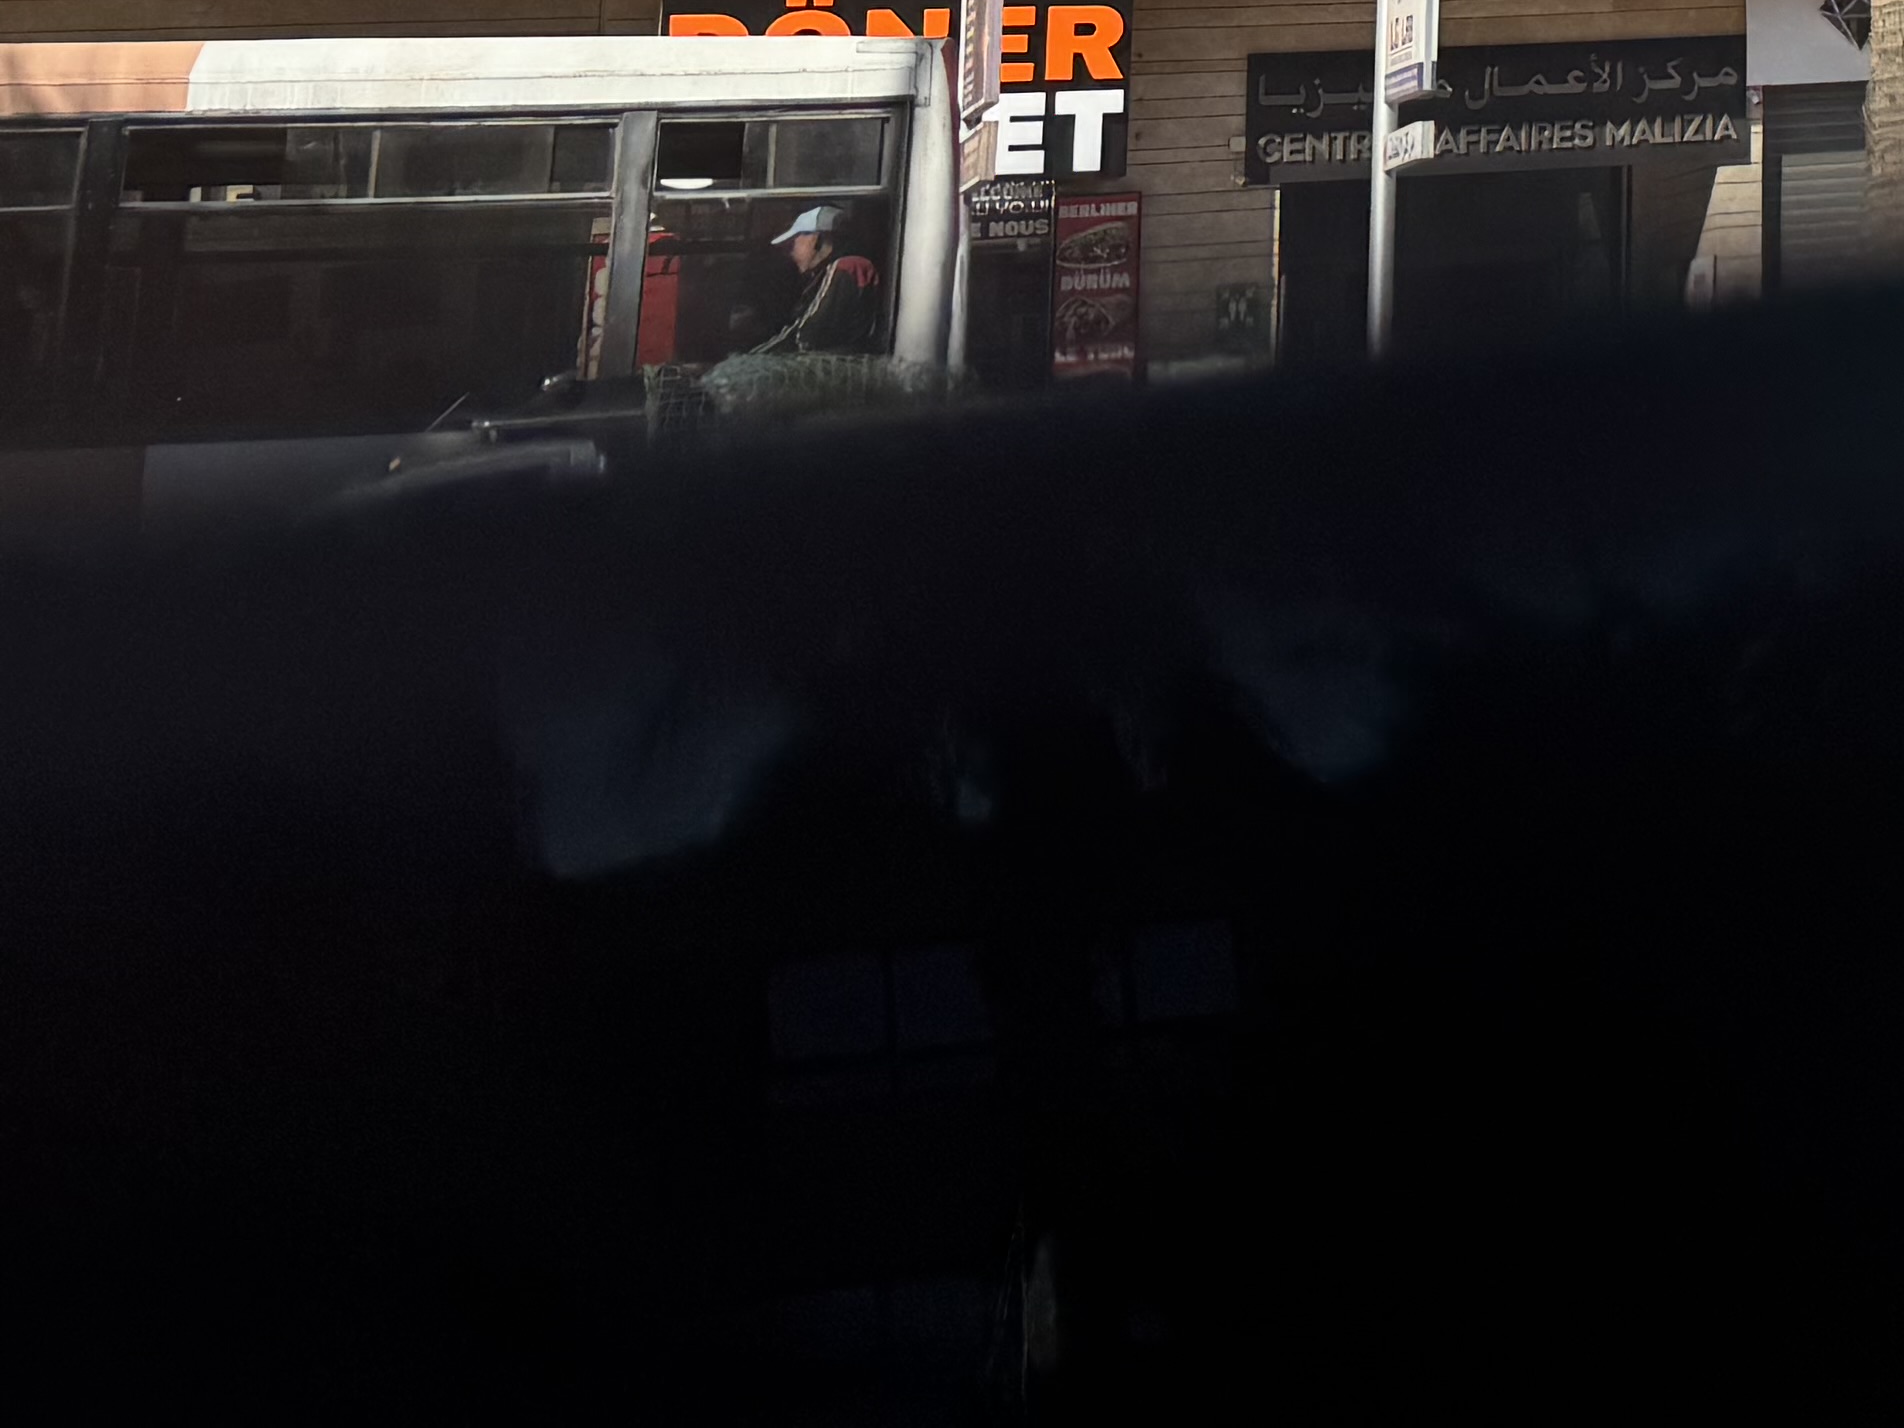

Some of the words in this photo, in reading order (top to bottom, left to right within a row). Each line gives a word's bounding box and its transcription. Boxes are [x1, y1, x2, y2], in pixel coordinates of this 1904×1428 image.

[1465, 53, 1624, 111] الأعمال
[1633, 58, 1740, 103] مركز
[1258, 131, 1373, 164] CENTR
[1605, 112, 1738, 148] MALIZIA
[1057, 201, 1138, 218] BERLINER
[989, 218, 1050, 237] NOUS
[1060, 269, 1131, 291] DÜRÜM
